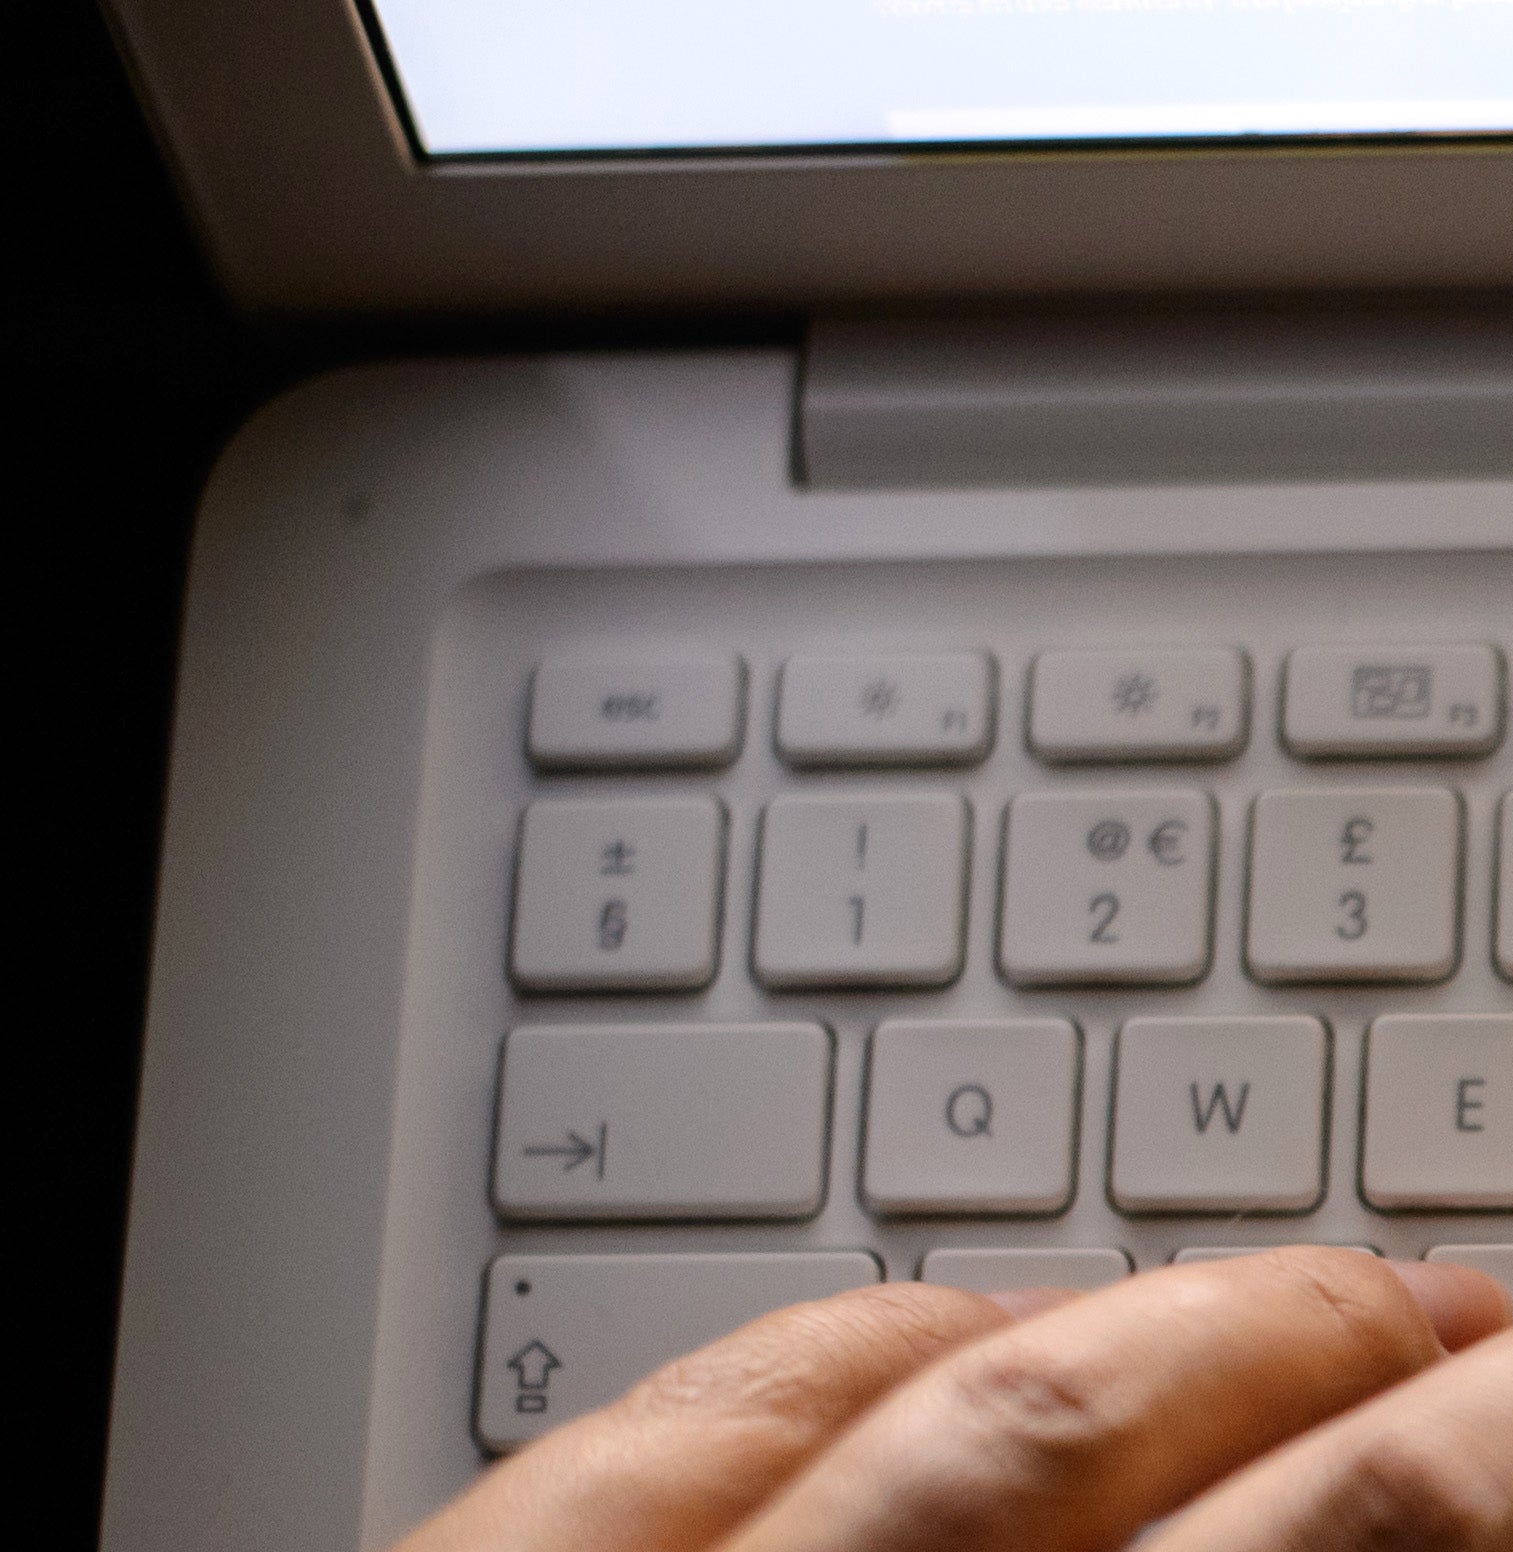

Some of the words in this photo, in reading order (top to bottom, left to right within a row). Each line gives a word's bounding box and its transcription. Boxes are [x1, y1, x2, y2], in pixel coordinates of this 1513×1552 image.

[854, 820, 870, 870] !
[1086, 819, 1131, 861] @
[1146, 819, 1186, 866] €
[1339, 815, 1374, 864] £
[846, 893, 867, 946] 1
[1088, 891, 1121, 944] 2
[1336, 889, 1369, 941] 3
[944, 1083, 994, 1138] Q
[1189, 1082, 1250, 1134] W
[1454, 1077, 1485, 1133] E
